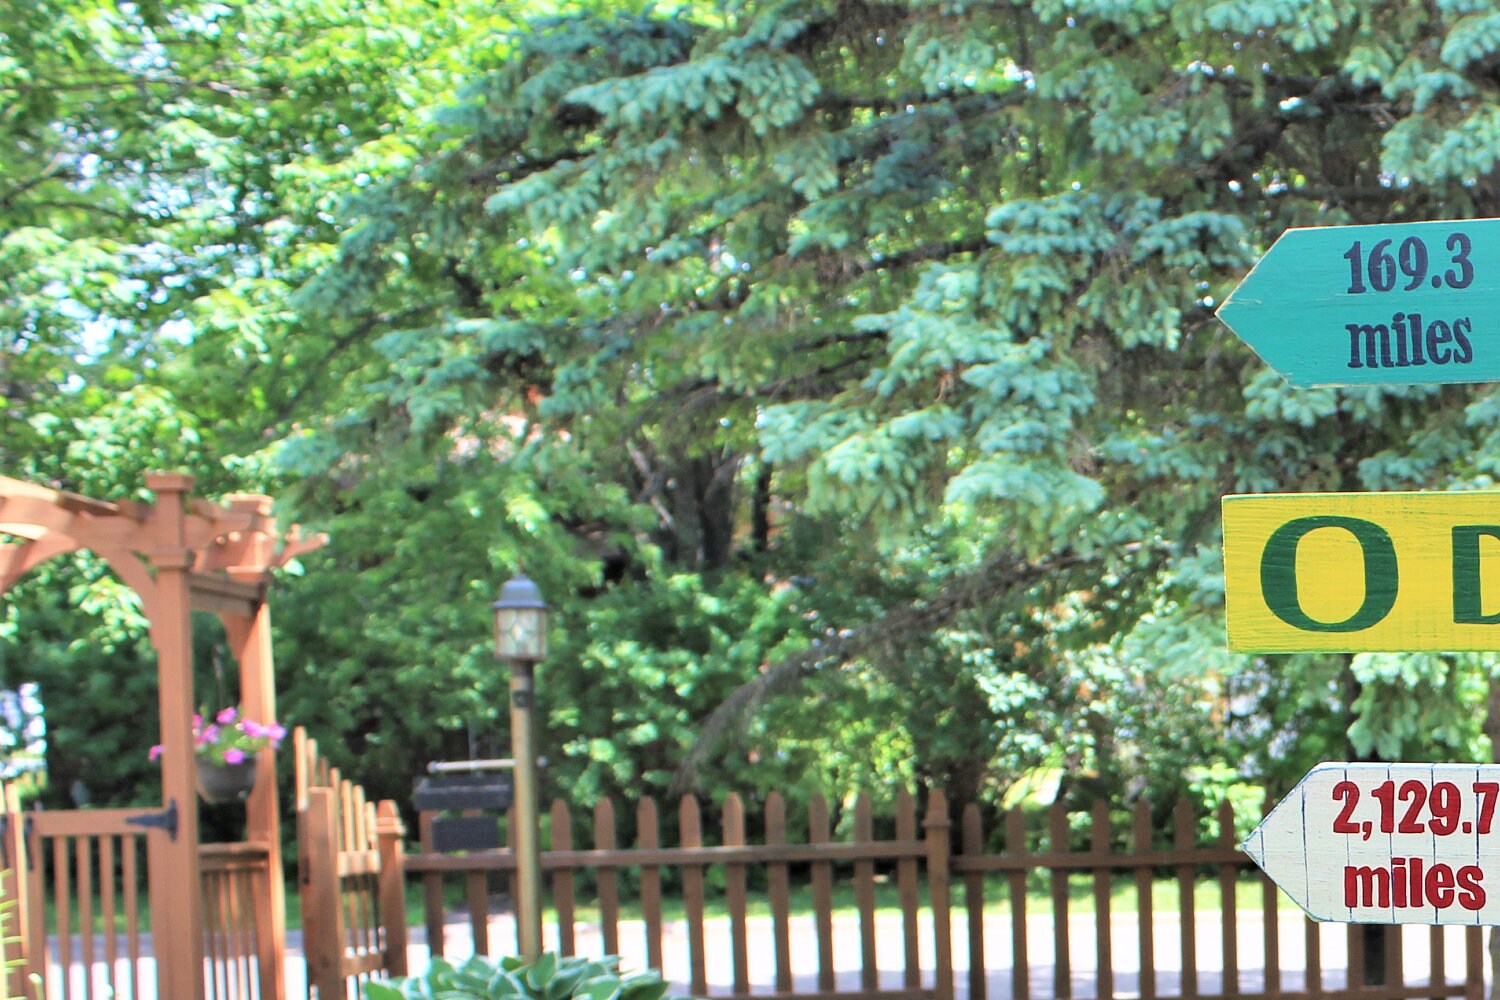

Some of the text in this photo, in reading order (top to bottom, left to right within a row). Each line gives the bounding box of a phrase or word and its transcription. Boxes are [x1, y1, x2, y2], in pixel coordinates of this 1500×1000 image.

[1343, 232, 1474, 295] 169.3
[1346, 313, 1473, 370] miles
[1260, 515, 1399, 632] O
[1331, 780, 1500, 840] 2,129.7
[1344, 858, 1486, 911] miles
